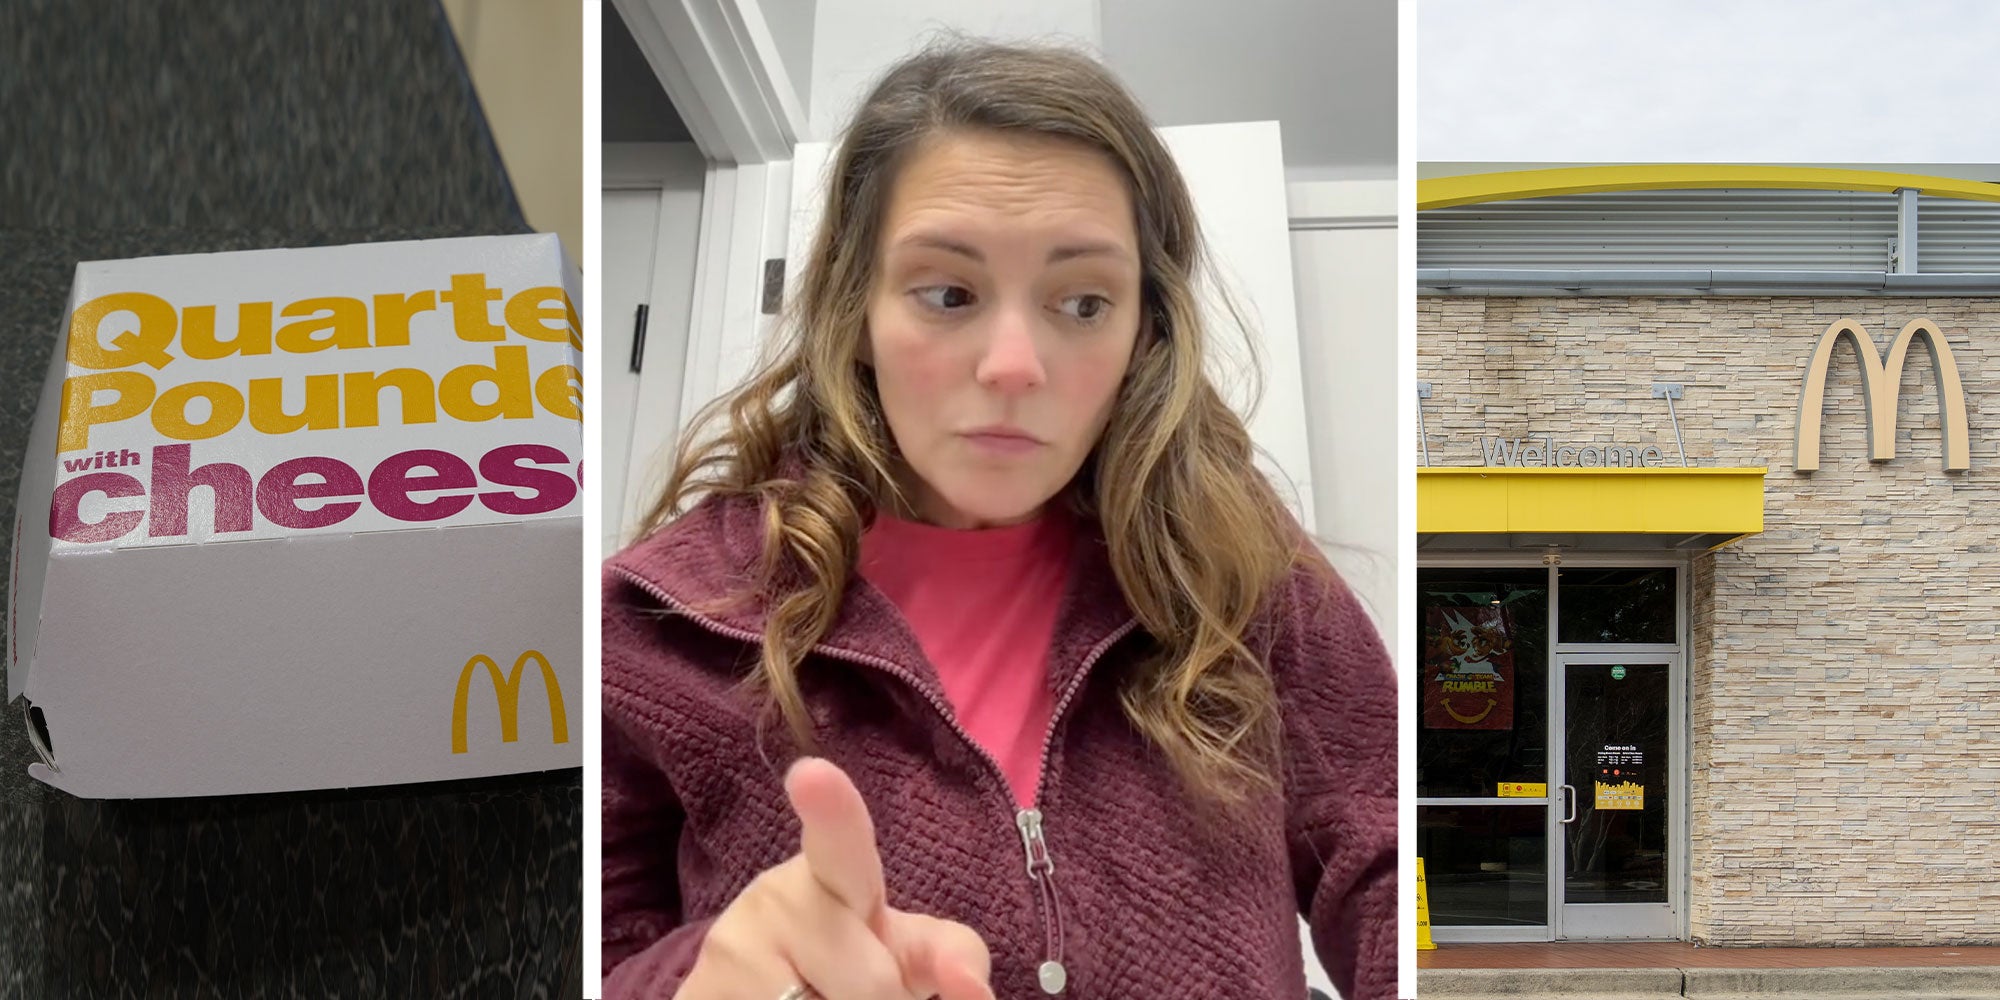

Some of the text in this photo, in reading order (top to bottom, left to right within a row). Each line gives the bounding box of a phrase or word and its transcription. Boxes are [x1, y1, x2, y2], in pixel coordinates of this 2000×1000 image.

[64, 448, 141, 472] with
[1480, 437, 1663, 467] Welcome
[49, 443, 583, 543] chees
[1442, 681, 1496, 692] RUMBLE
